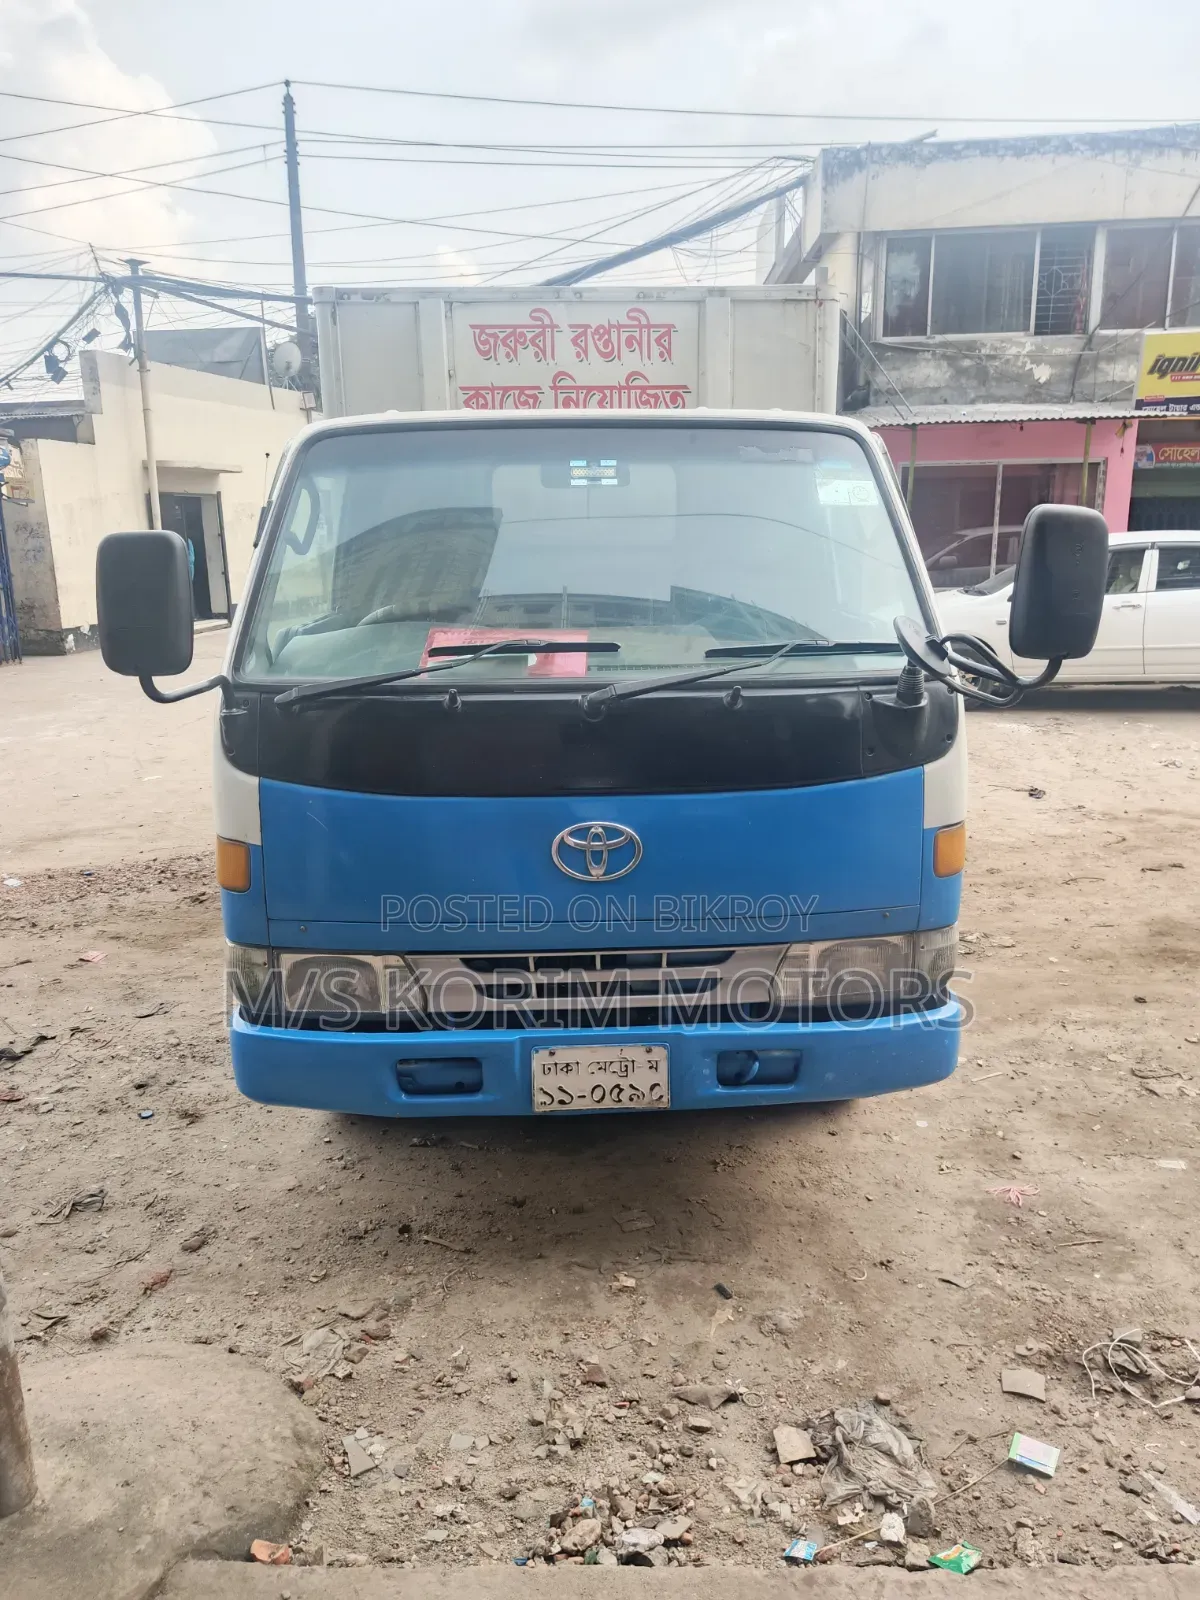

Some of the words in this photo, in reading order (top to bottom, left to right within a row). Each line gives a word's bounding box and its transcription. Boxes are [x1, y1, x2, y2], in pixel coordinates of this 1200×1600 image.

[468, 307, 563, 366] জরুরী
[567, 307, 678, 366] রপ্তানীর
[1159, 445, 1200, 461] সোহেল
[540, 1060, 581, 1076] ঢাকা
